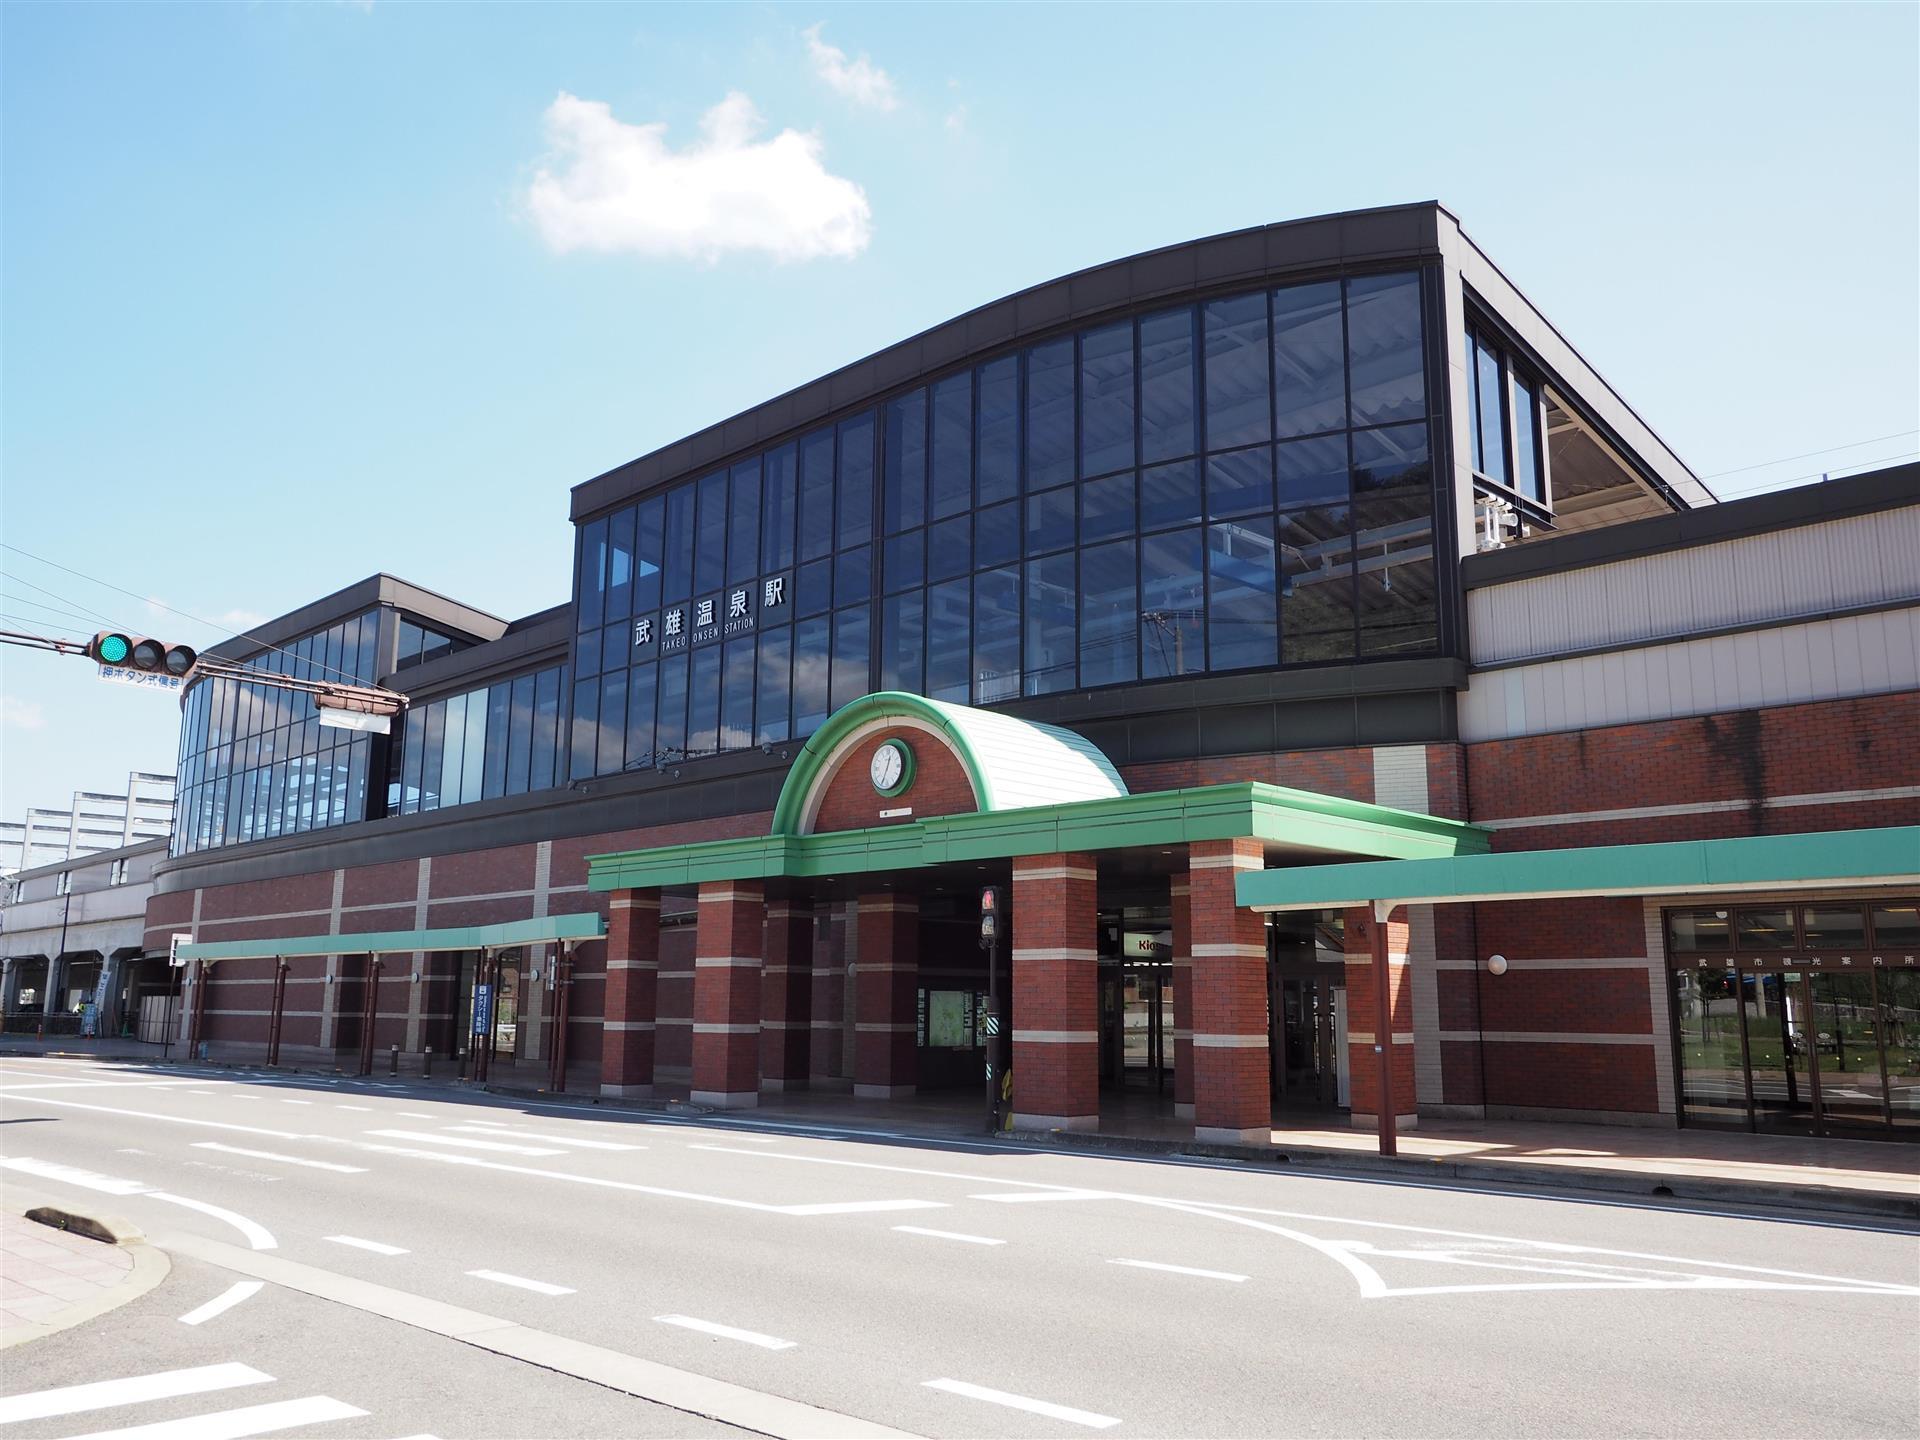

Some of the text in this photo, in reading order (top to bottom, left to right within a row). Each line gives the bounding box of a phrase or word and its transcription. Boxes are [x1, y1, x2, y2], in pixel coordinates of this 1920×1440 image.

[635, 577, 783, 646] 武雄温泉駅
[662, 616, 755, 652] TAKEO ONSEN STATION
[1698, 955, 1914, 967] 武雄市観光案内所
